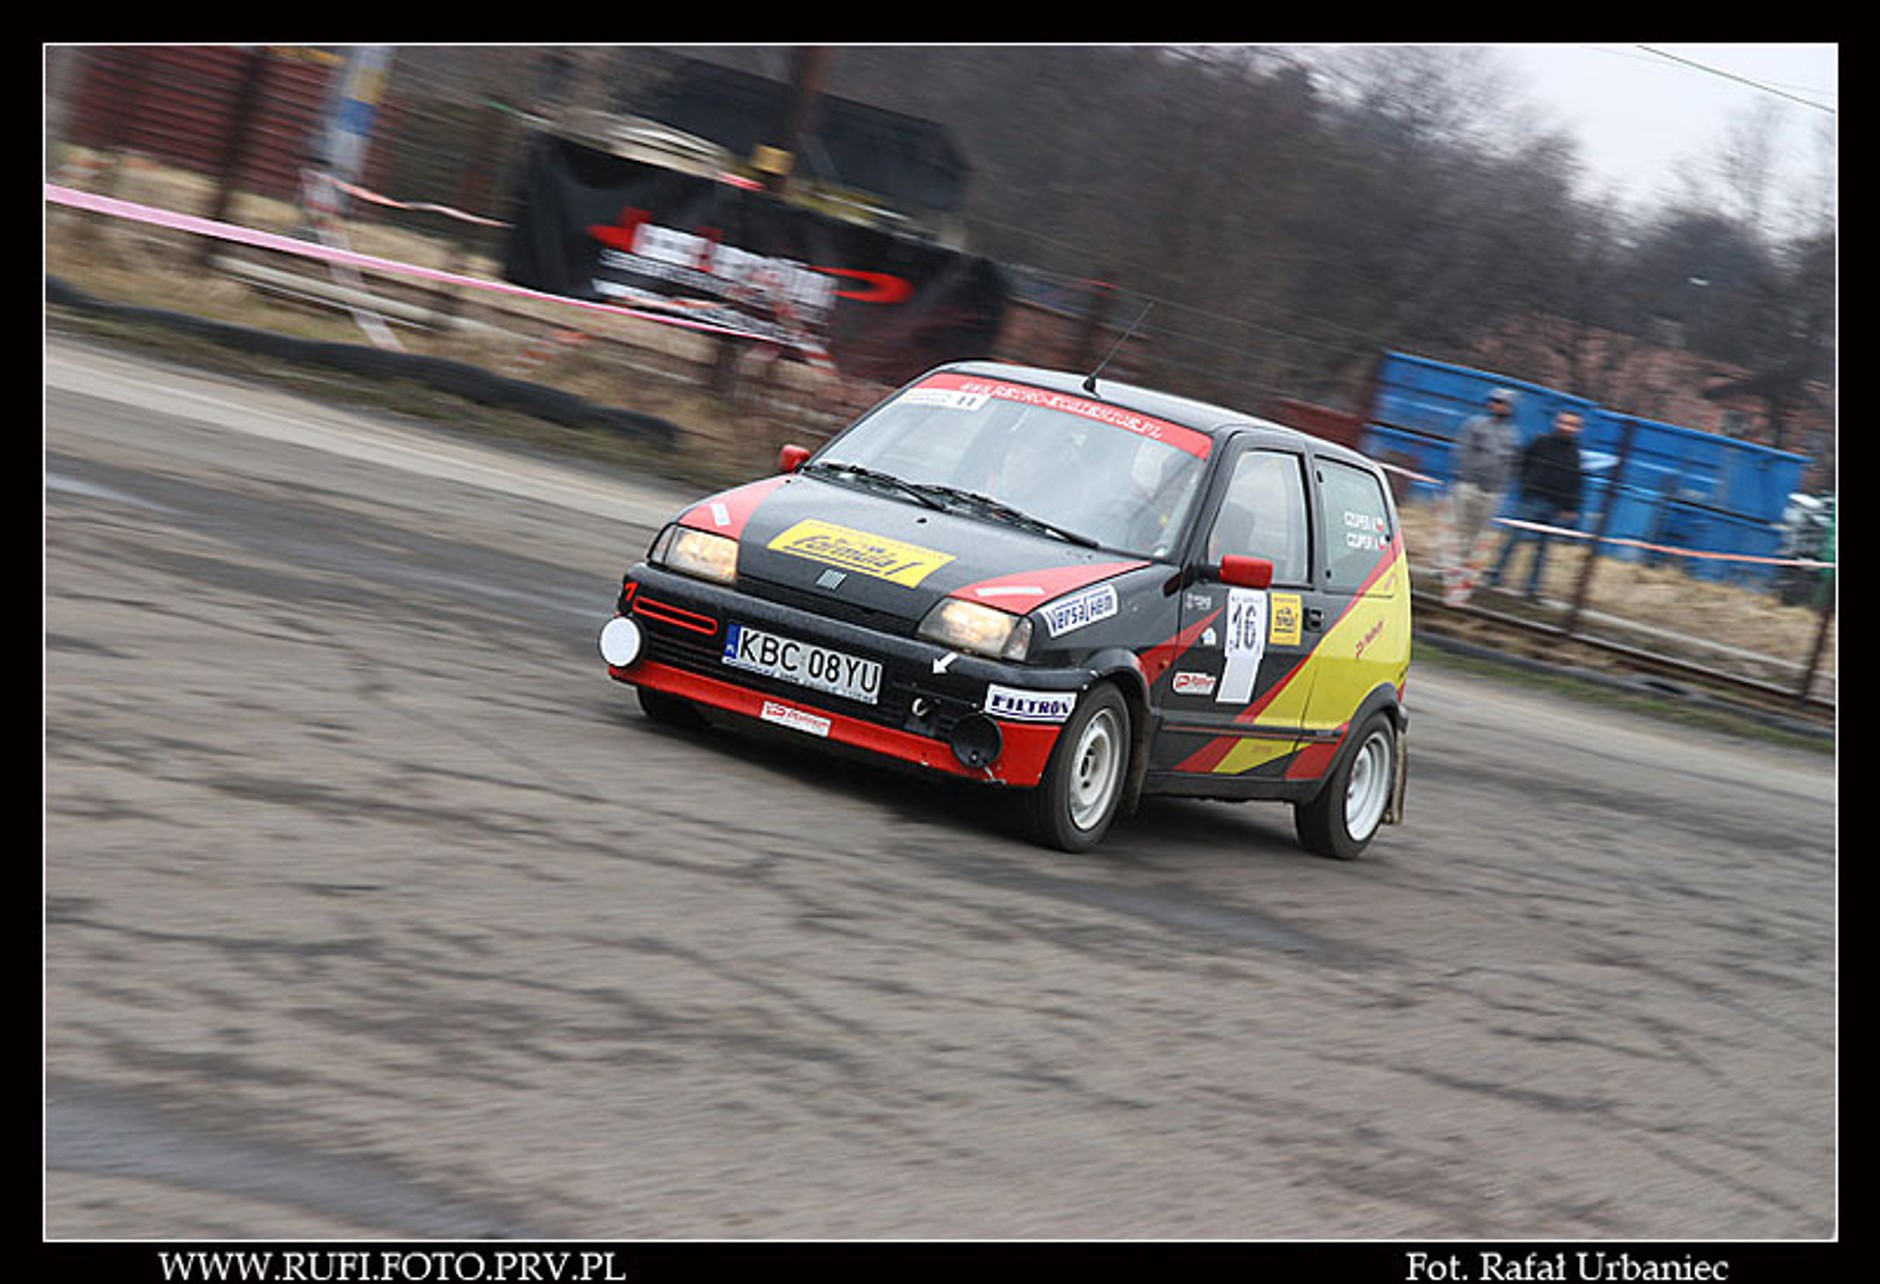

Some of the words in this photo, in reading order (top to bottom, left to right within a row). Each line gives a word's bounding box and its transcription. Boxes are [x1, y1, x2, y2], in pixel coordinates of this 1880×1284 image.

[1231, 603, 1257, 651] 16
[739, 629, 800, 672] KBC
[808, 648, 880, 694] 08YU
